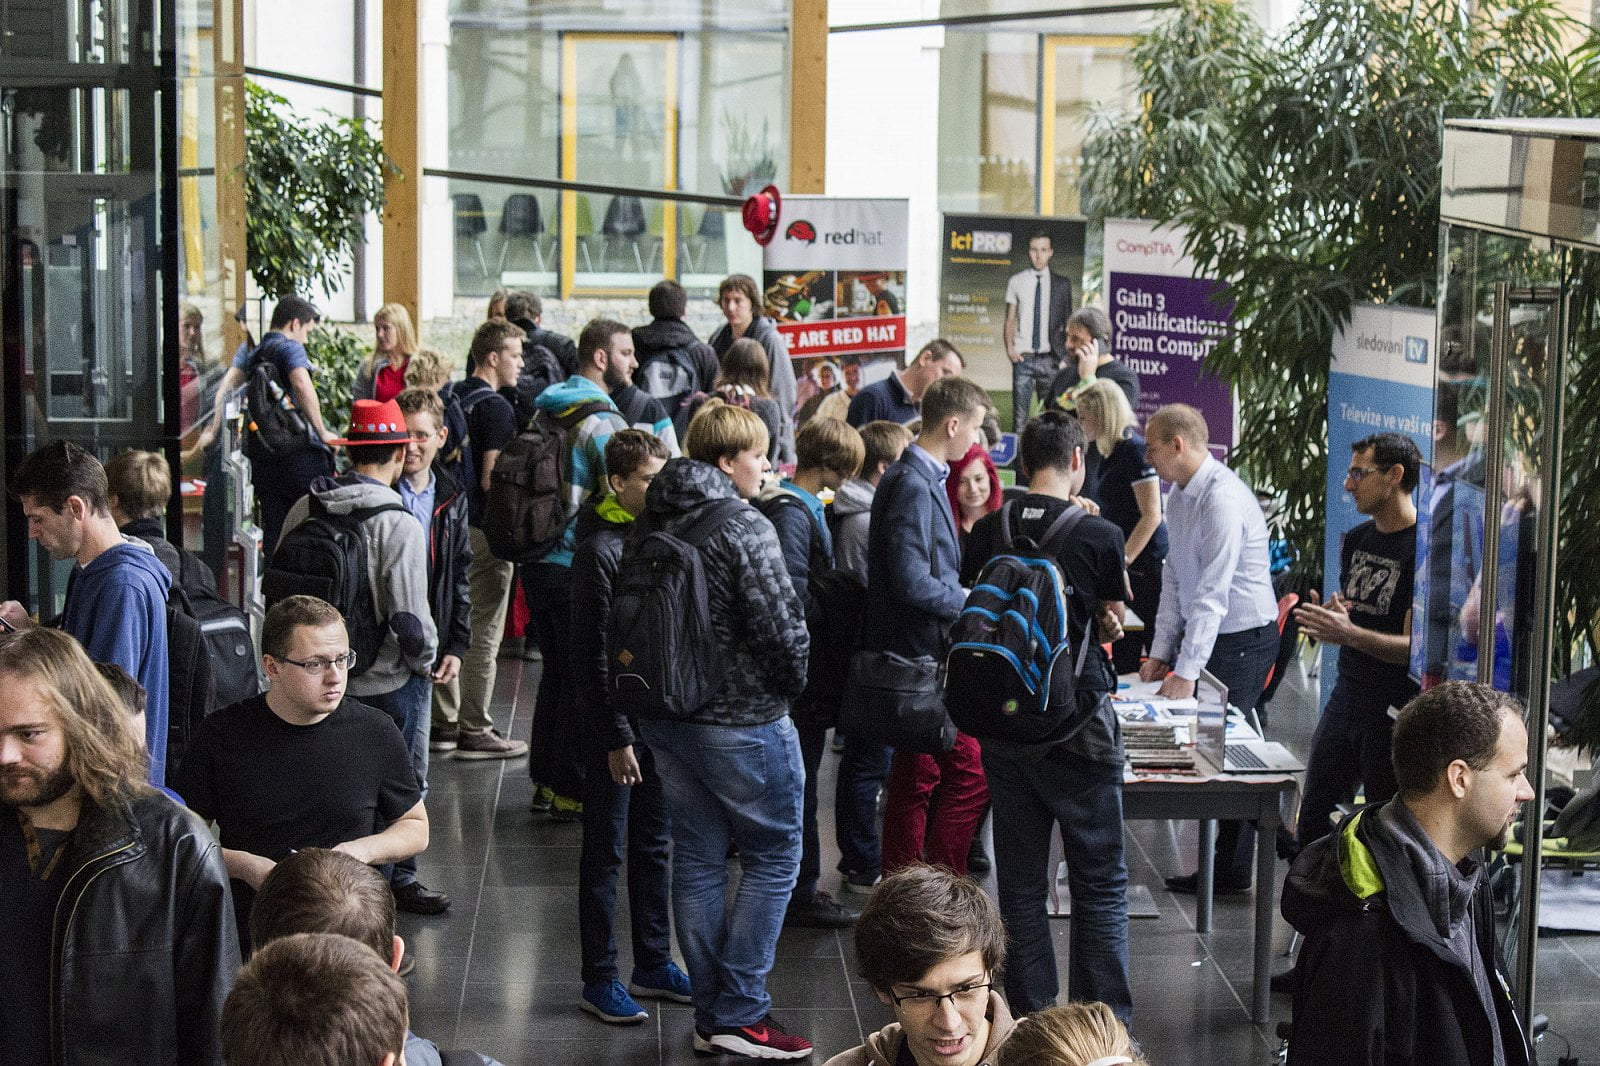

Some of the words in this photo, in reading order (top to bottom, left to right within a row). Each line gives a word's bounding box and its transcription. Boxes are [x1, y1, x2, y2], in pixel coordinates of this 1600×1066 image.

[825, 229, 883, 245] redhat
[1116, 239, 1175, 256] CompTIA
[1116, 288, 1153, 308] Gain
[1155, 292, 1166, 312] 3
[1115, 310, 1228, 337] Qualifications
[798, 329, 829, 348] ARE
[832, 326, 864, 345] RED
[866, 324, 897, 342] HAT
[1115, 331, 1154, 352] from
[1115, 354, 1169, 376] inux+
[1340, 402, 1381, 428] Televize
[1383, 414, 1396, 431] ve
